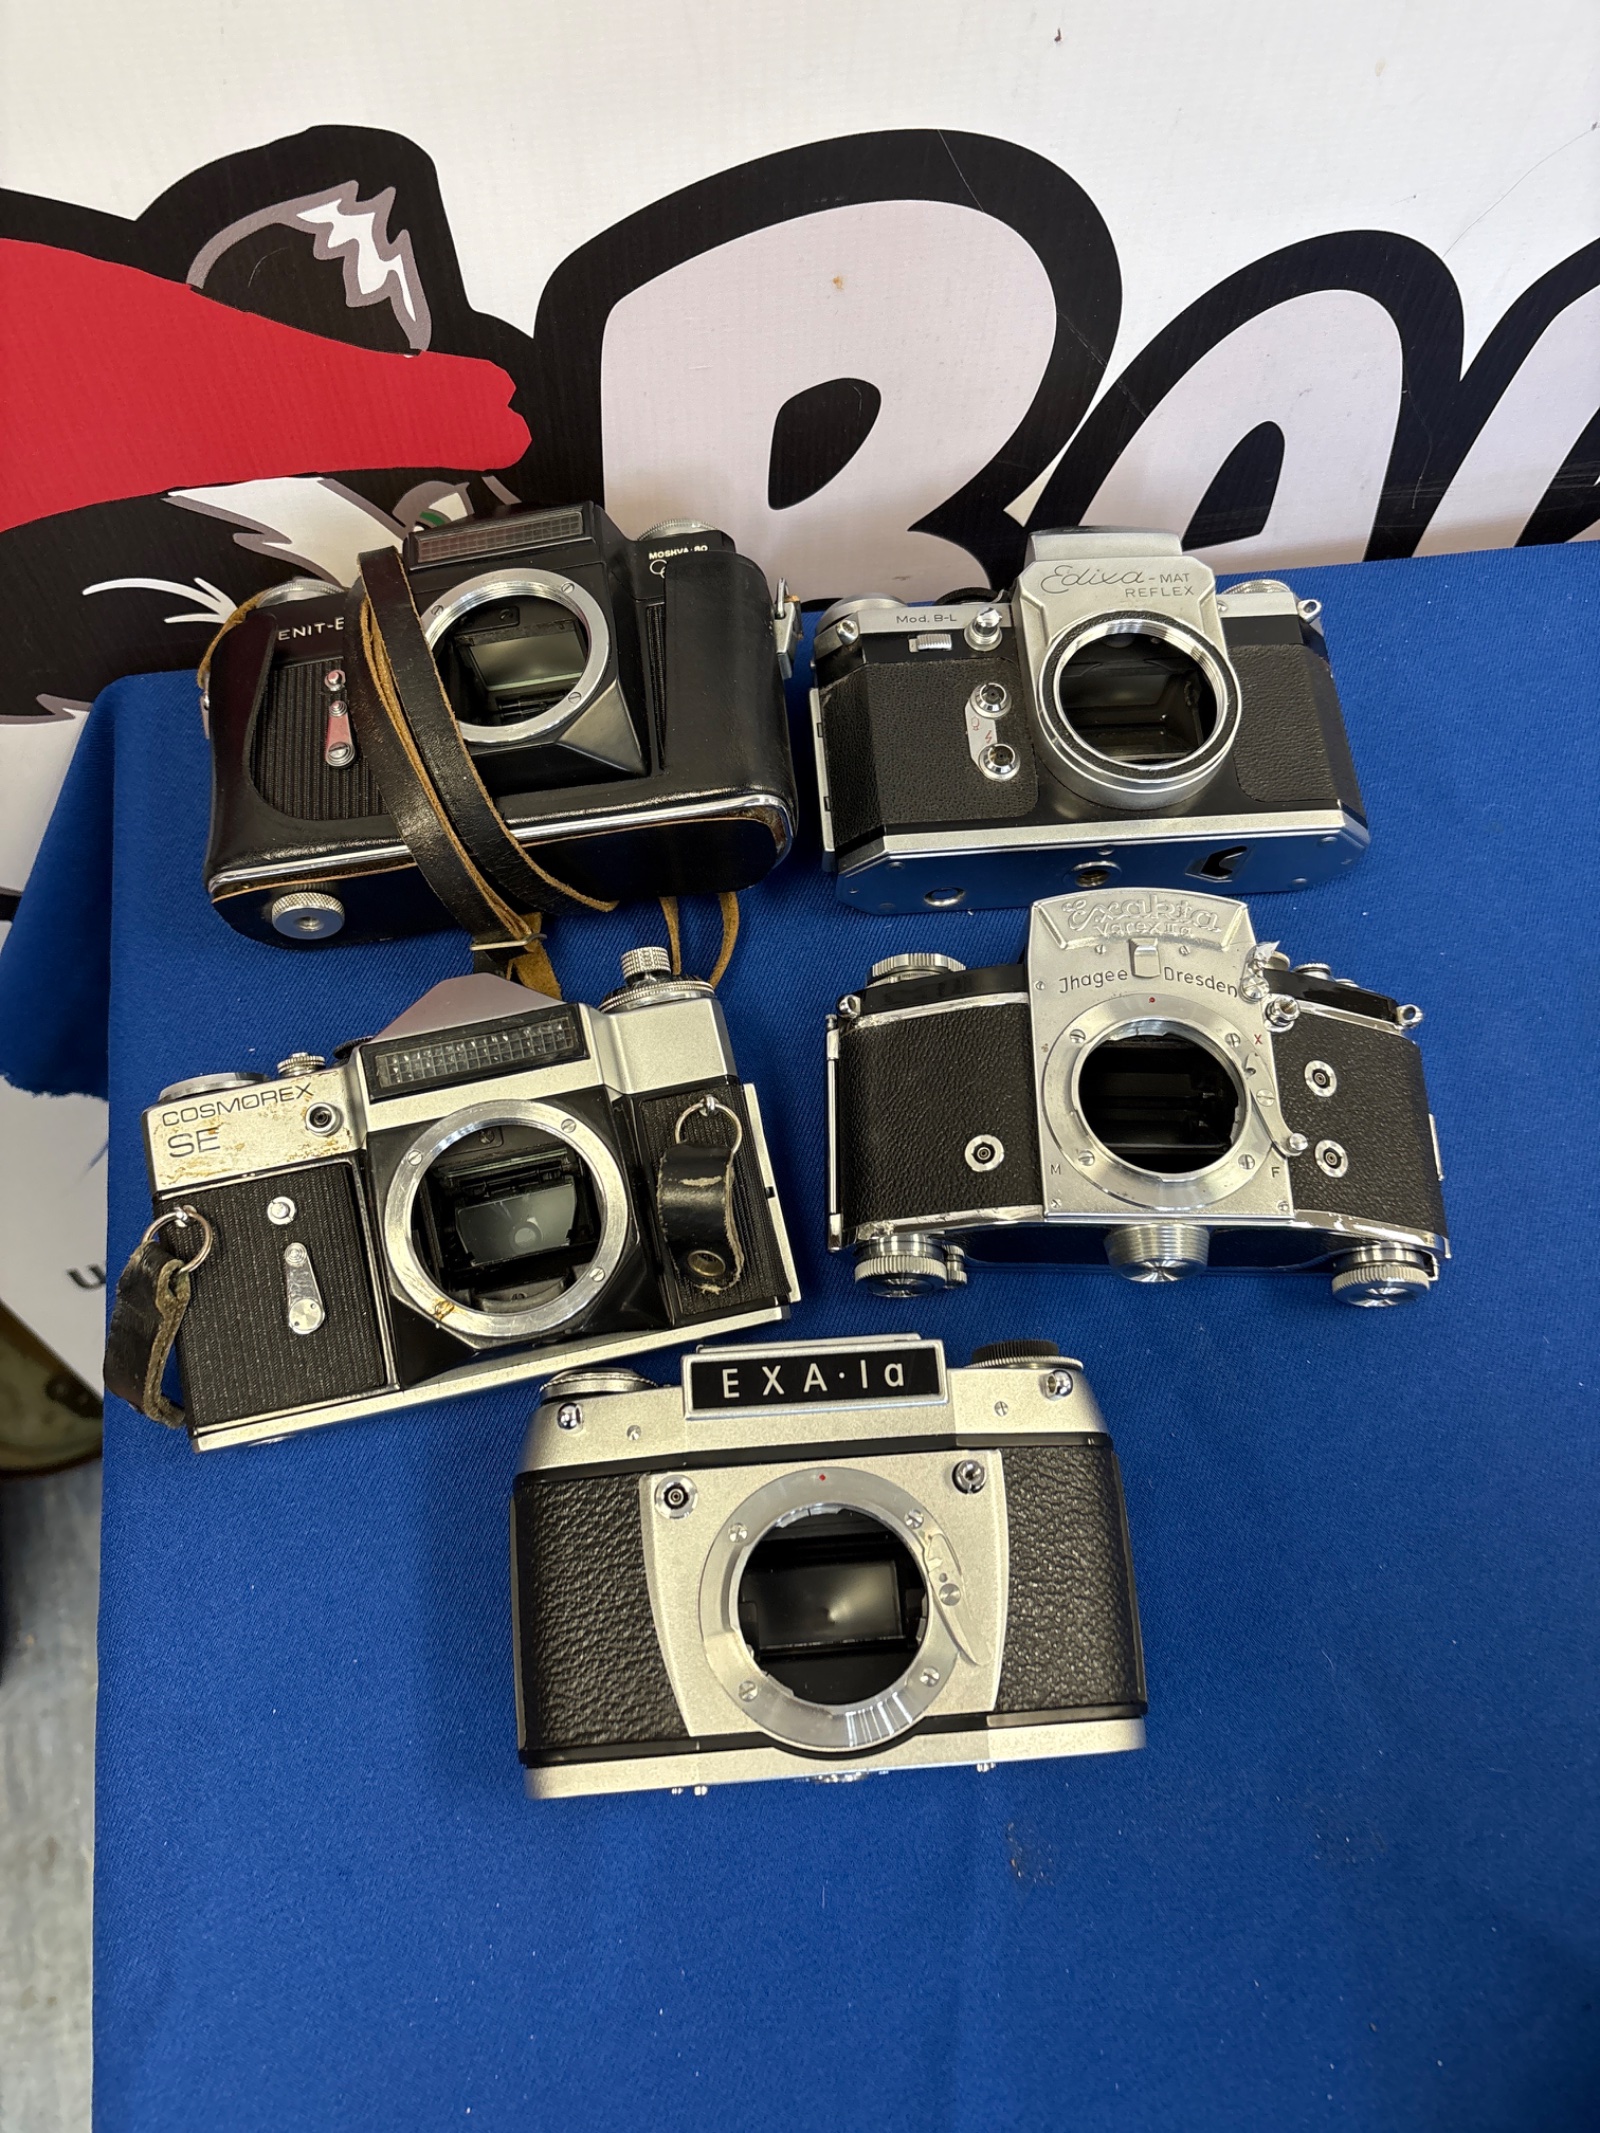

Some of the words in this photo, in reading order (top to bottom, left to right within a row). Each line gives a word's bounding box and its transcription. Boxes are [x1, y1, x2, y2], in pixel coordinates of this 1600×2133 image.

[1125, 585, 1194, 598] REFLEX
[278, 616, 345, 641] ENIT-E
[896, 615, 930, 624] Mod.
[933, 614, 957, 622] B-L
[1061, 894, 1223, 933] Exakta
[1163, 966, 1239, 998] Dresden
[161, 1081, 315, 1127] COSMOREX
[167, 1126, 221, 1158] SE
[1049, 1163, 1062, 1176] M
[1270, 1166, 1281, 1179] F
